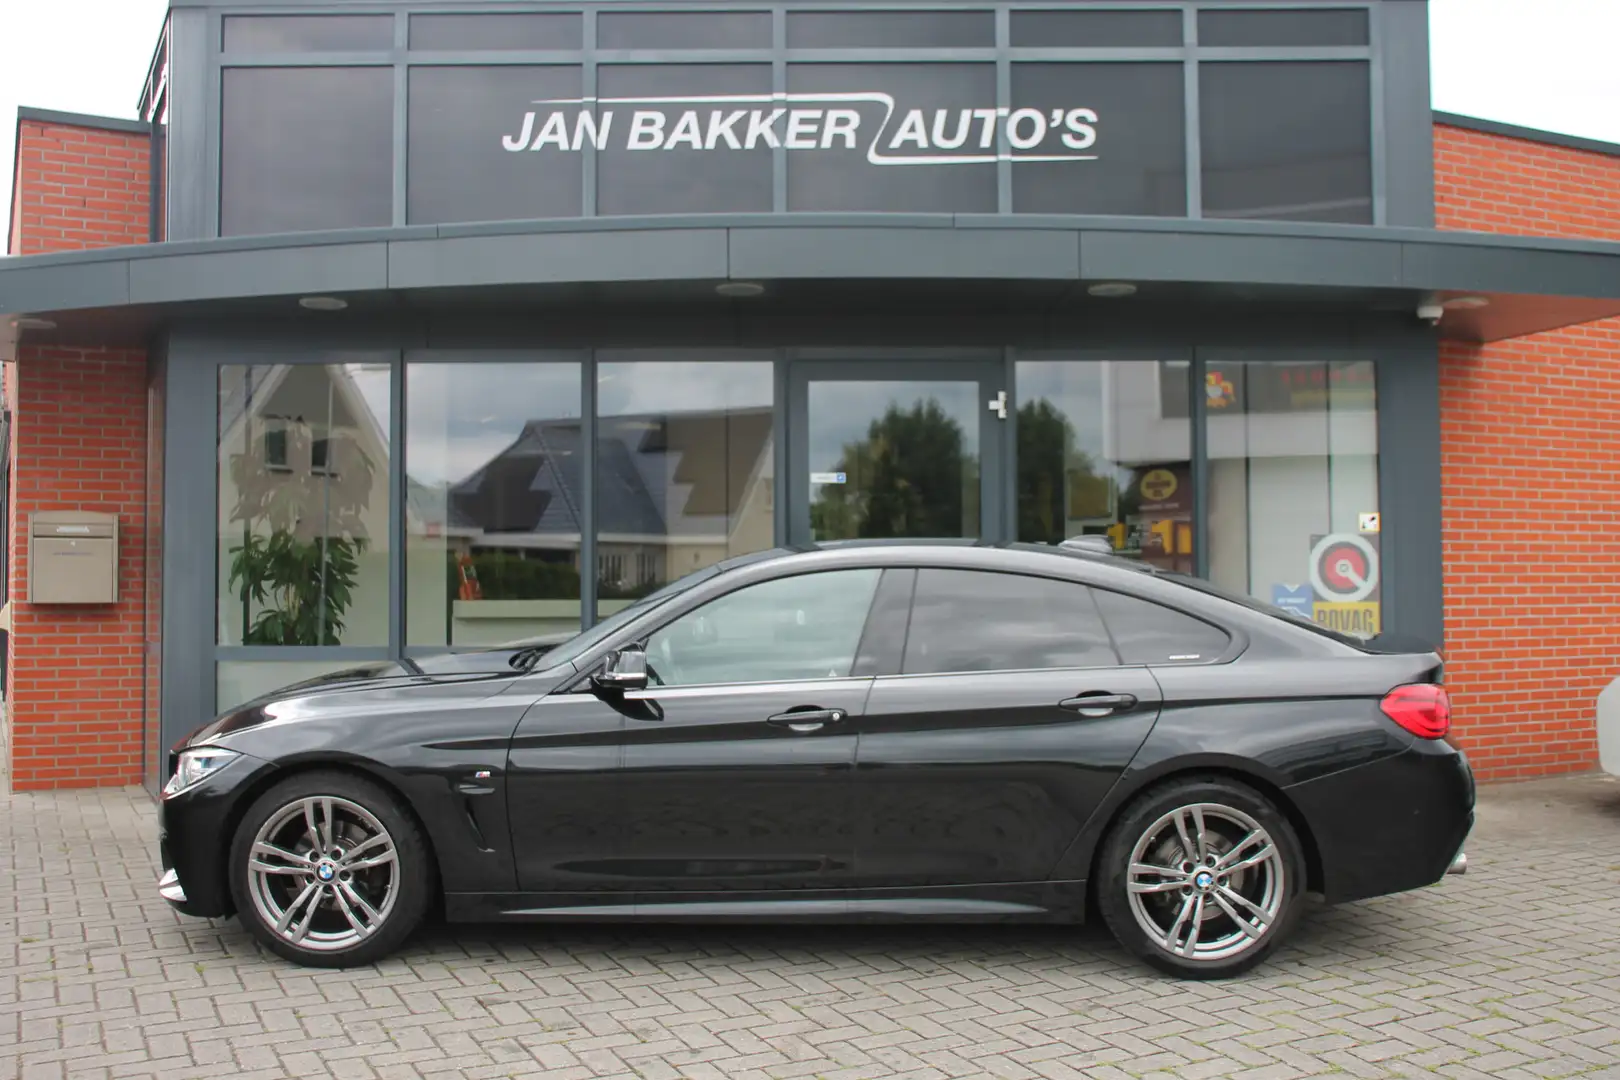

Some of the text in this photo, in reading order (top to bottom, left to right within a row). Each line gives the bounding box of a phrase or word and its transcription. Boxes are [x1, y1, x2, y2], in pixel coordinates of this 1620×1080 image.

[502, 107, 1099, 151] JAN BAKKER AUTO'S
